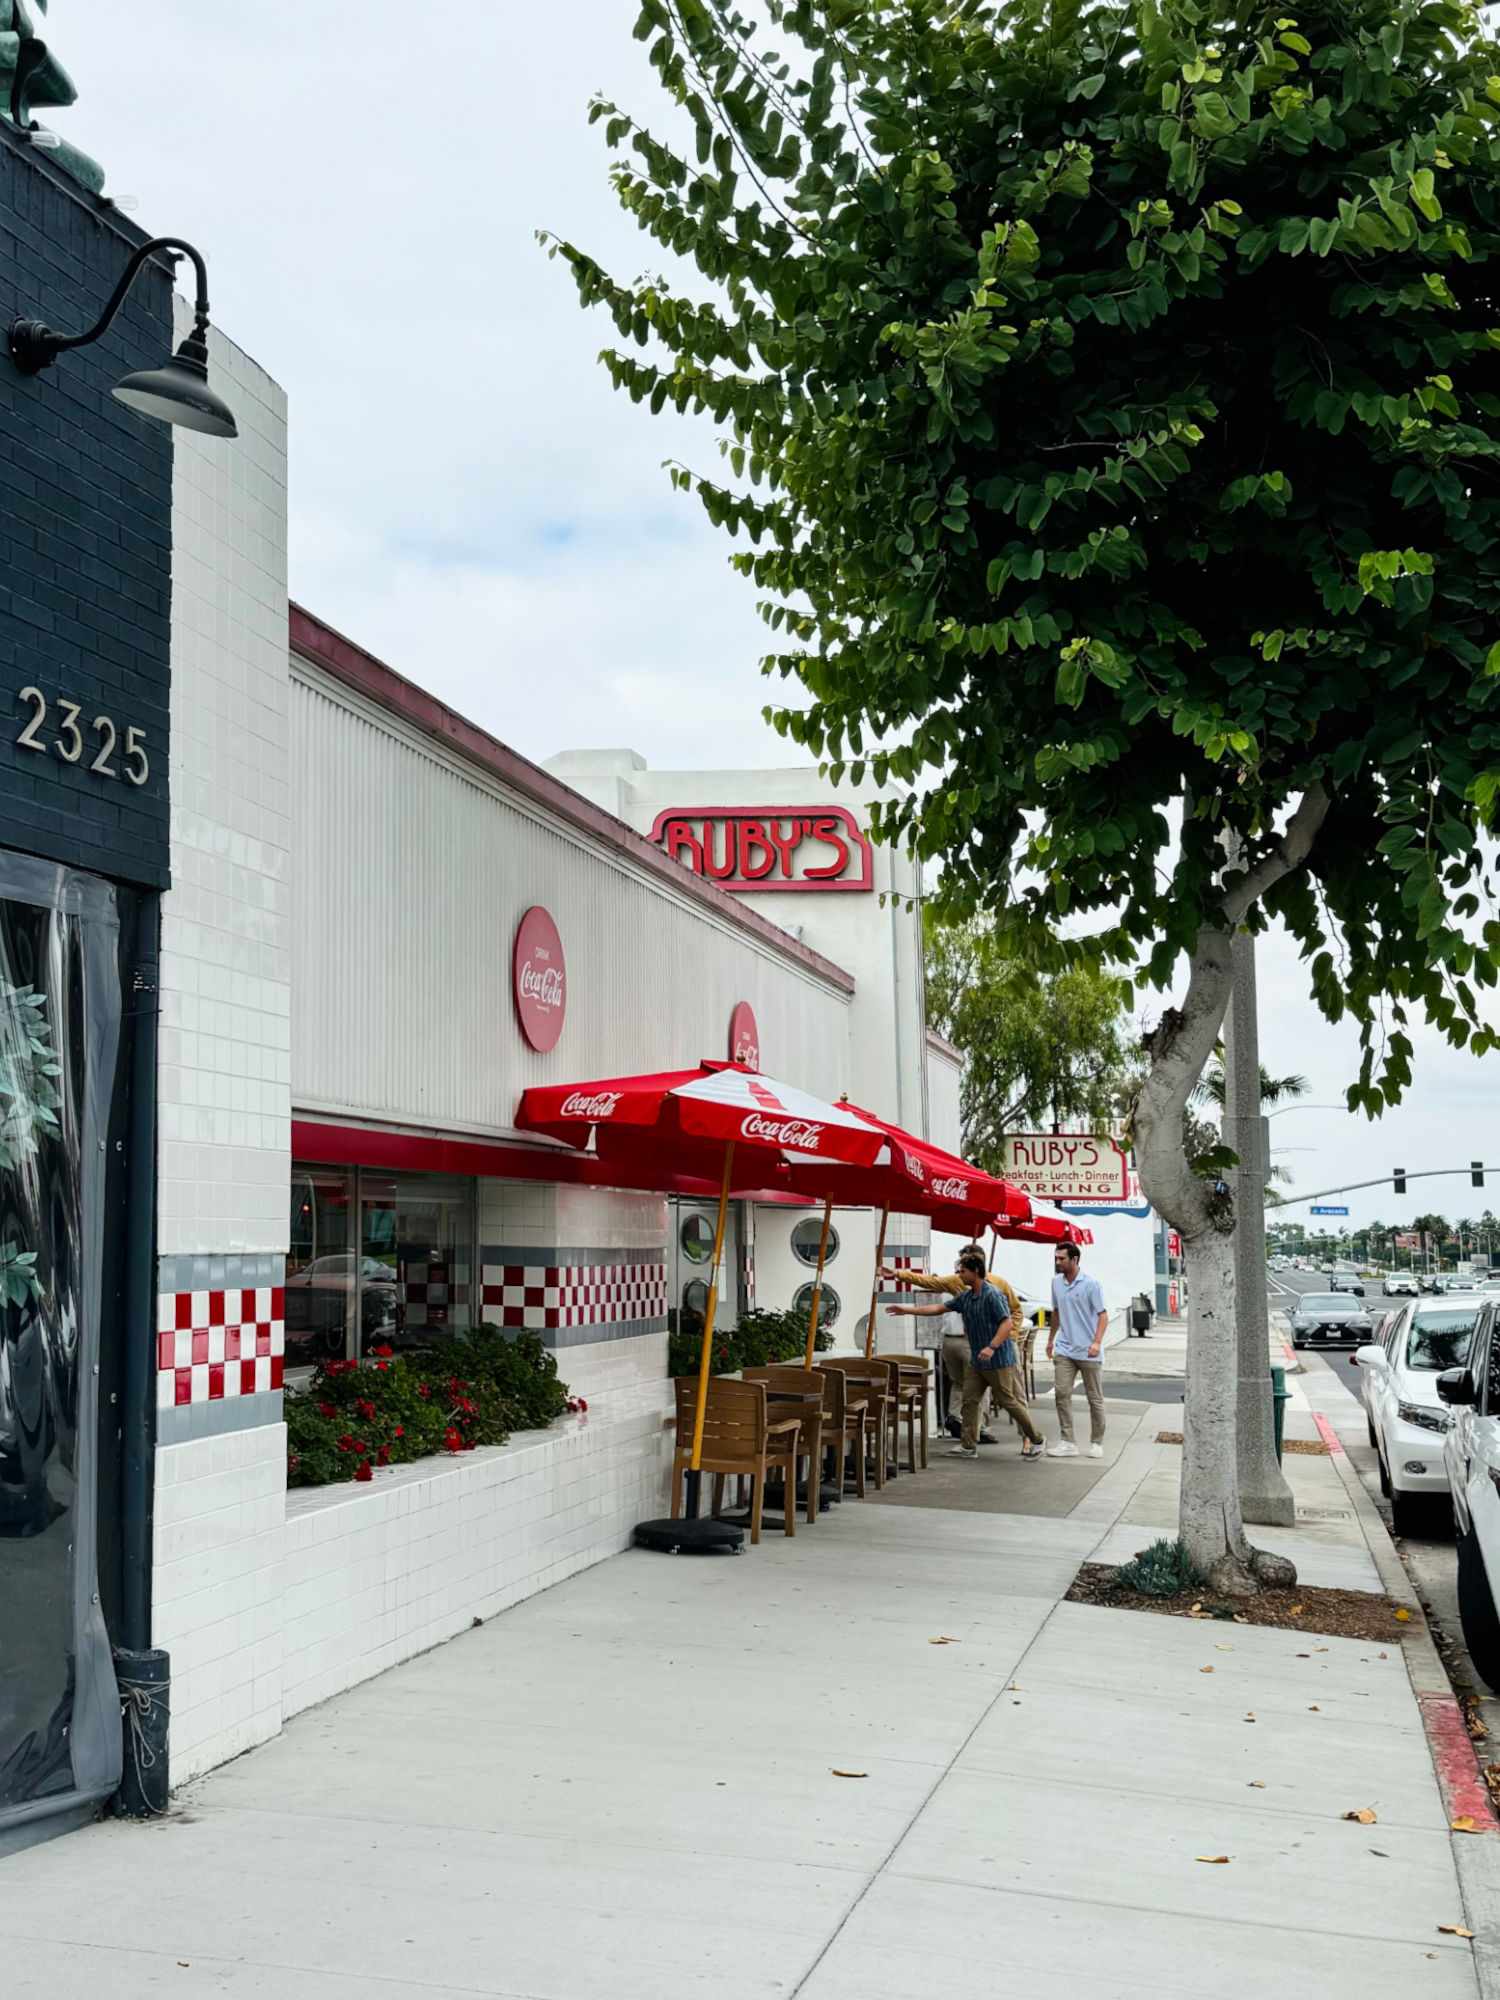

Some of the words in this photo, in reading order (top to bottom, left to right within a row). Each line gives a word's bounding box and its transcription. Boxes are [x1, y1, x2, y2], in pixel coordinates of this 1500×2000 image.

[16, 686, 149, 785] 2325
[668, 820, 849, 878] RUBY'S
[520, 961, 563, 1006] Coca-Cola
[560, 1092, 624, 1116] Coca-Cola
[741, 1113, 824, 1150] Coca-Cola
[1013, 1141, 1099, 1166] RUBY'S
[1019, 1183, 1112, 1194] ARKING
[1050, 1170, 1082, 1180] Lunch
[1085, 1171, 1119, 1181] Dinner
